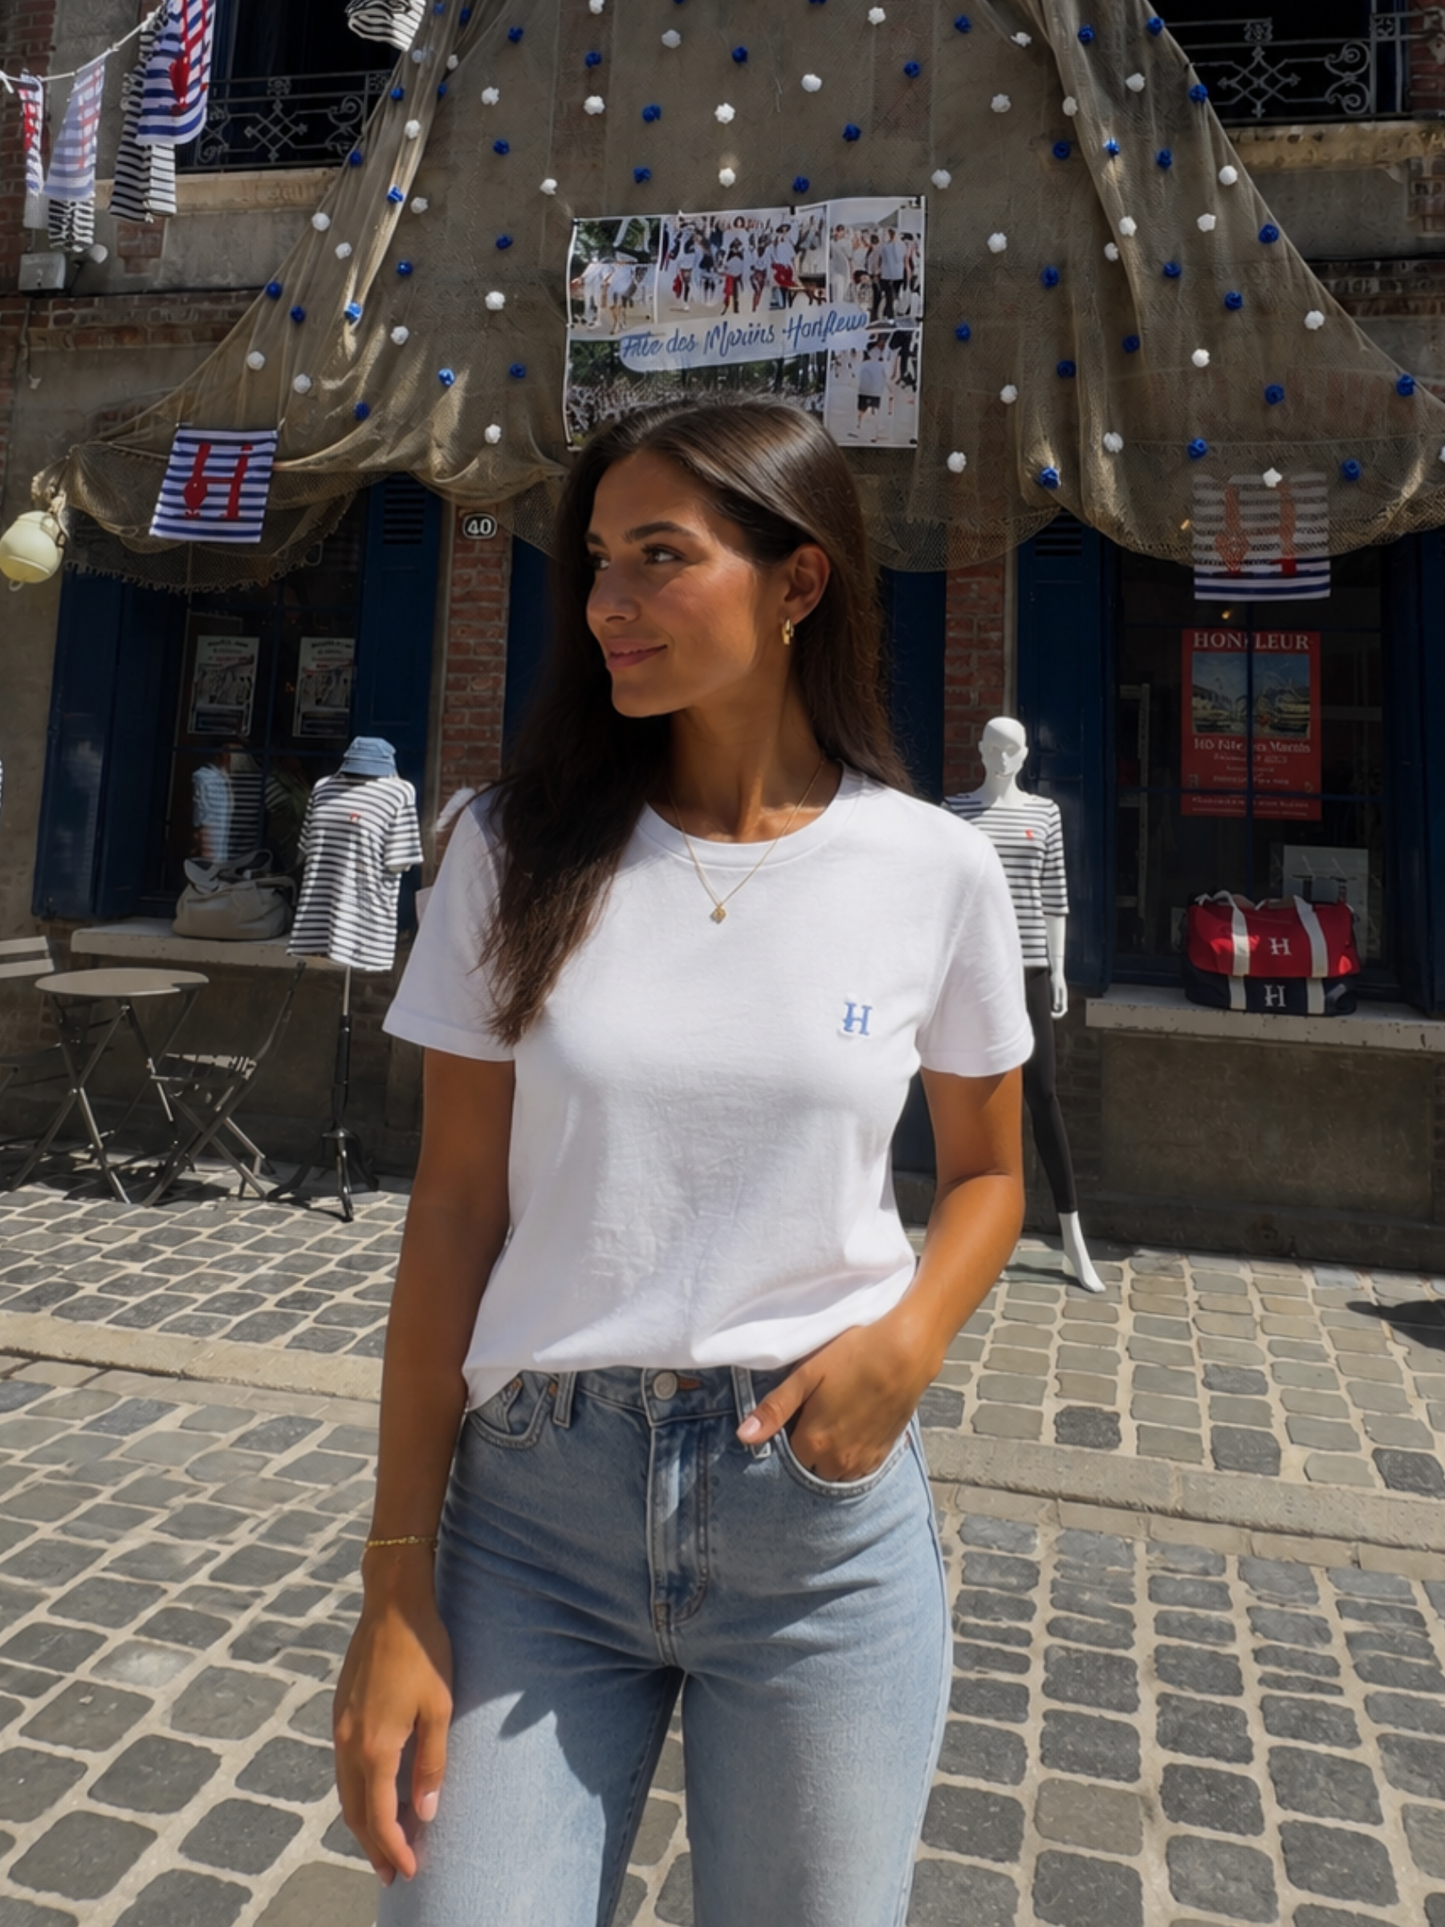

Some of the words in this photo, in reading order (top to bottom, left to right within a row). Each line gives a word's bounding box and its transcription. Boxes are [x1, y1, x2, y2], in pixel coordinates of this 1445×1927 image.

[467, 518, 492, 535] 40
[1268, 937, 1292, 956] H
[1264, 984, 1286, 1007] H
[842, 1001, 872, 1036] H
